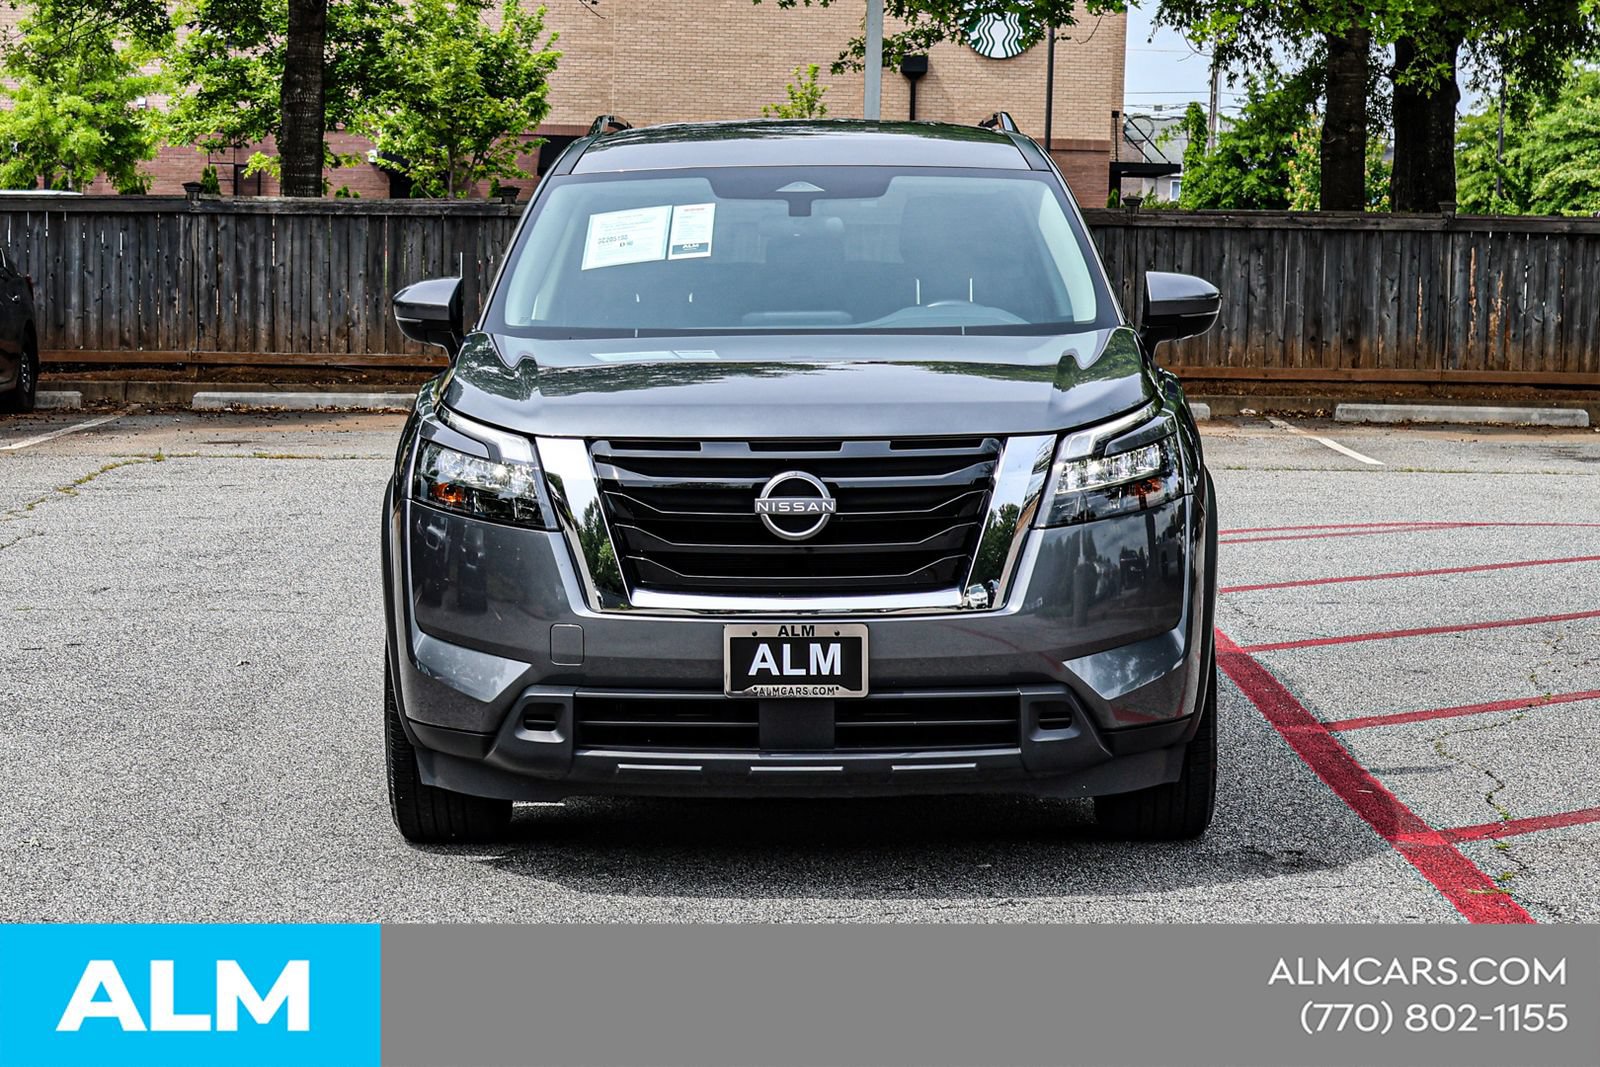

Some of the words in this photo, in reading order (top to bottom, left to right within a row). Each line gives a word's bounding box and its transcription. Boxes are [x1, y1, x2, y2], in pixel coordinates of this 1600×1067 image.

[757, 502, 834, 512] NISSAN
[778, 625, 814, 637] ALM
[748, 643, 842, 676] ALM
[758, 686, 835, 696] ALMCARS.COM
